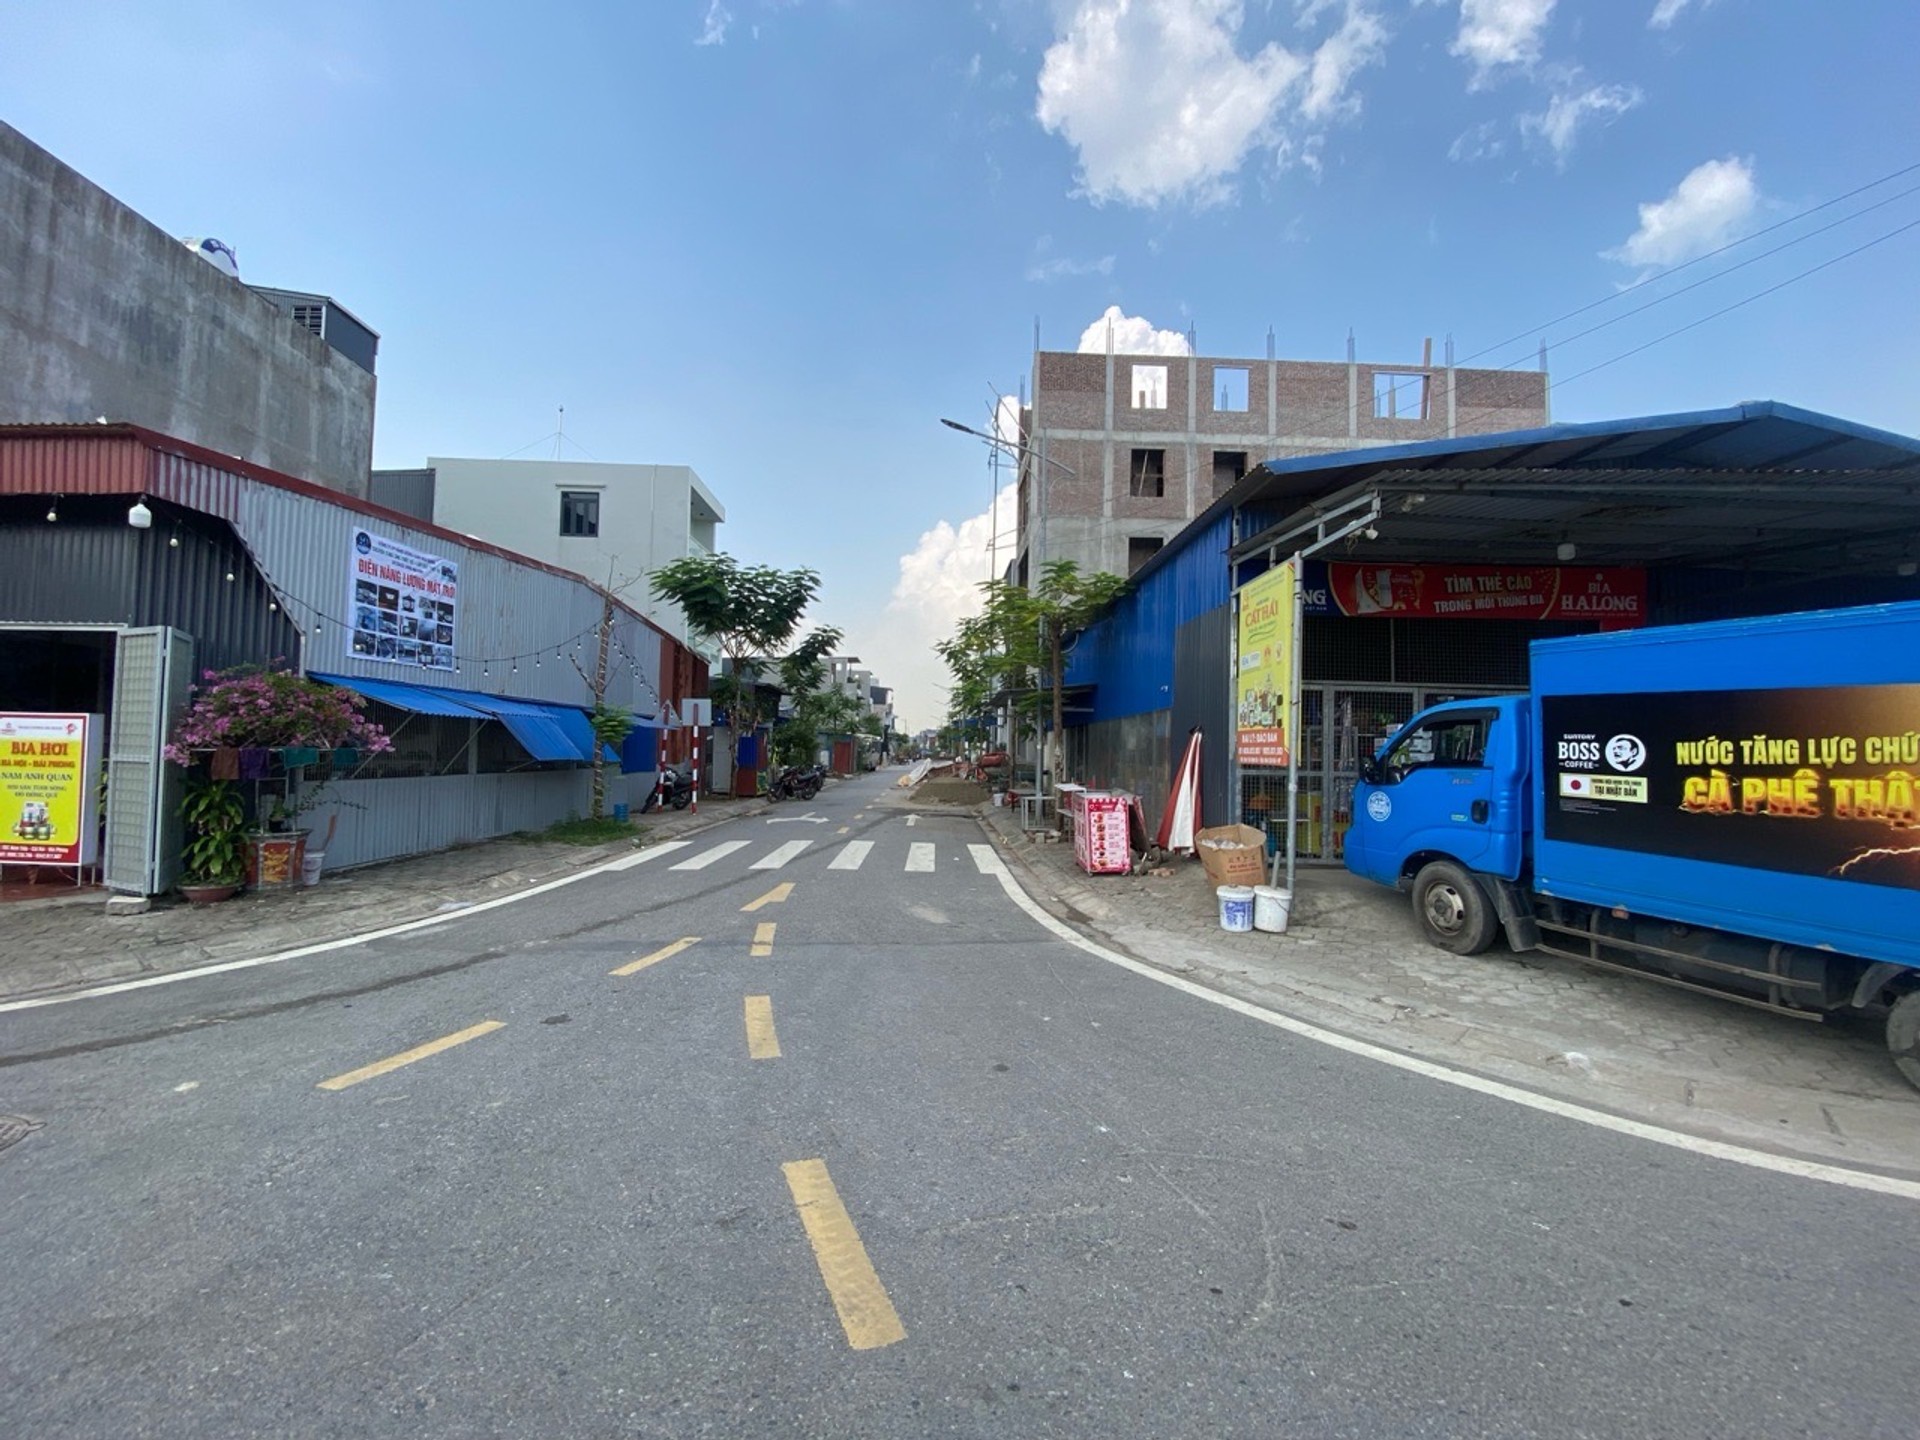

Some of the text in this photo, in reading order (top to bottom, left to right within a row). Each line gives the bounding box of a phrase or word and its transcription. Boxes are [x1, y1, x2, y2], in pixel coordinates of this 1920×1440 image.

[358, 558, 378, 578] ĐIỆN
[379, 565, 401, 583] NĂNG
[402, 571, 426, 591] LƯỢNG
[427, 579, 441, 597] MẶT
[1444, 574, 1473, 593] TÌM
[1476, 572, 1503, 592] THẺ
[1588, 583, 1611, 594] BIA
[1433, 600, 1472, 614] TRONG
[11, 741, 36, 755] BIA
[1558, 741, 1600, 761] BOSS
[1676, 735, 1734, 765] NƯỚC
[1740, 734, 1800, 765] TĂNG
[1807, 736, 1856, 769] LỰC
[1, 772, 22, 780] NAM
[24, 772, 44, 780] ANH
[1682, 768, 1733, 815] CÀ
[1741, 767, 1822, 817] PHÊ
